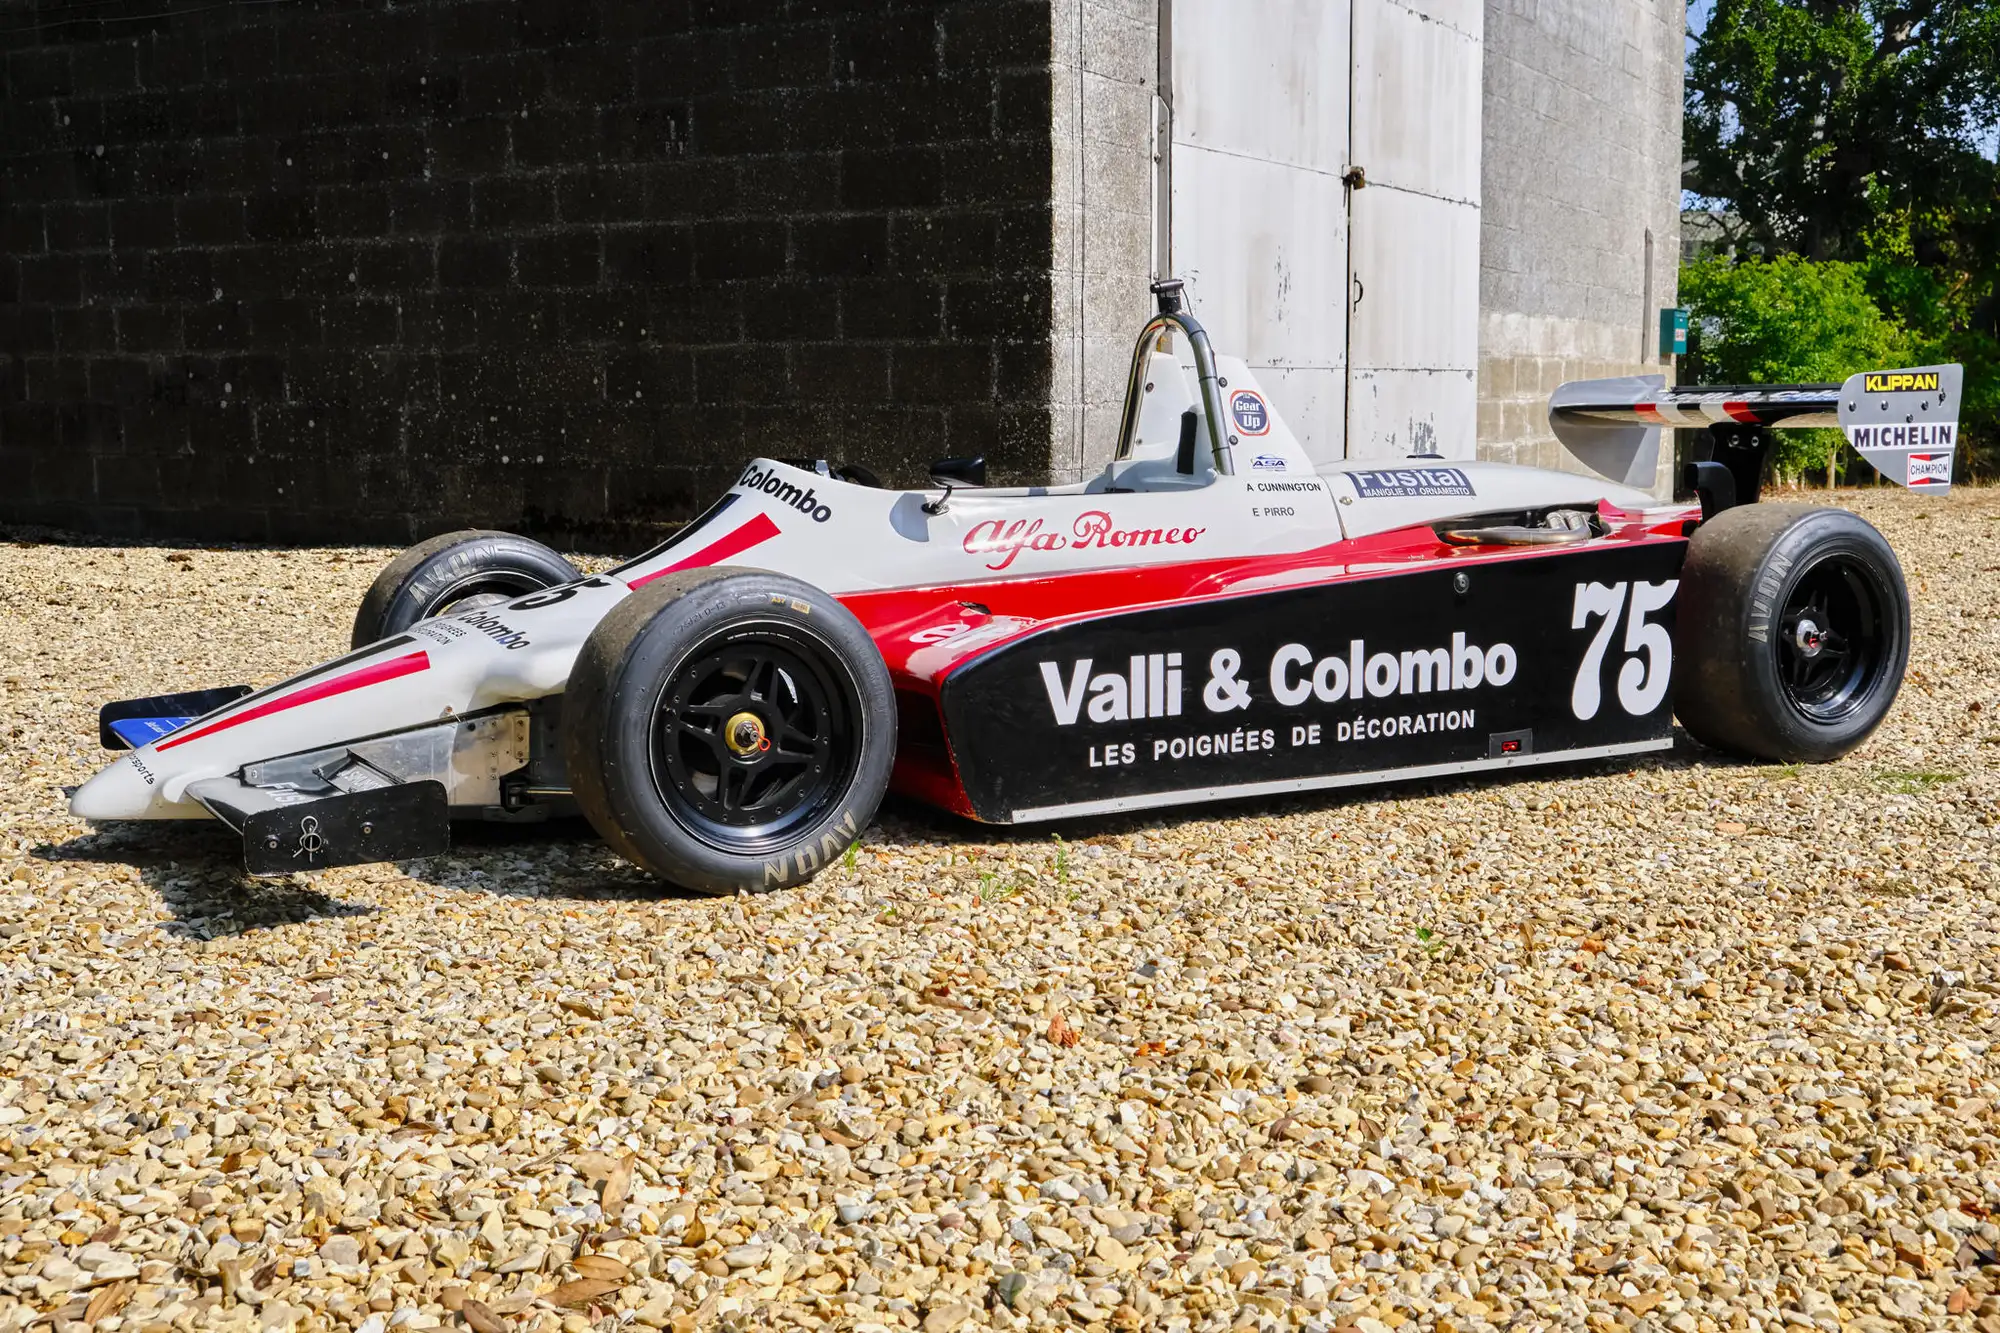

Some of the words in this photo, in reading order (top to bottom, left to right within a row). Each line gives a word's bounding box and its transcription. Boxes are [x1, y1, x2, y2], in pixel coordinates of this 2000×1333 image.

[1866, 374, 1938, 391] KLIPPAN
[1235, 400, 1261, 411] Gear
[1243, 414, 1260, 428] Up
[1854, 426, 1952, 447] MICHELIN
[1350, 469, 1466, 488] Fusital
[1910, 463, 1948, 475] CHAMPION
[739, 465, 832, 522] Colombo
[1246, 483, 1254, 492] A
[1257, 482, 1321, 492] CUNNINGTON
[1362, 487, 1405, 497] MANIGLIE
[1407, 487, 1417, 496] DI
[1420, 486, 1470, 496] ORNAMENTO
[1252, 507, 1260, 517] E
[1264, 507, 1295, 517] PIRRO
[963, 518, 1067, 570] Alfa
[1071, 510, 1206, 549] Romeo
[408, 543, 499, 608] AVON
[508, 577, 612, 611] 5
[1748, 551, 1794, 643] AVON
[457, 610, 531, 650] Colombo
[1571, 579, 1680, 721] 75
[1039, 652, 1182, 726] Valli
[1203, 648, 1252, 713] &
[1270, 631, 1518, 706] Colombo
[1089, 743, 1136, 768] LES
[1153, 727, 1275, 761] POIGNÉES
[1292, 724, 1321, 746] DE
[1337, 709, 1475, 742] DÉCORATION
[763, 808, 857, 886] AVON
